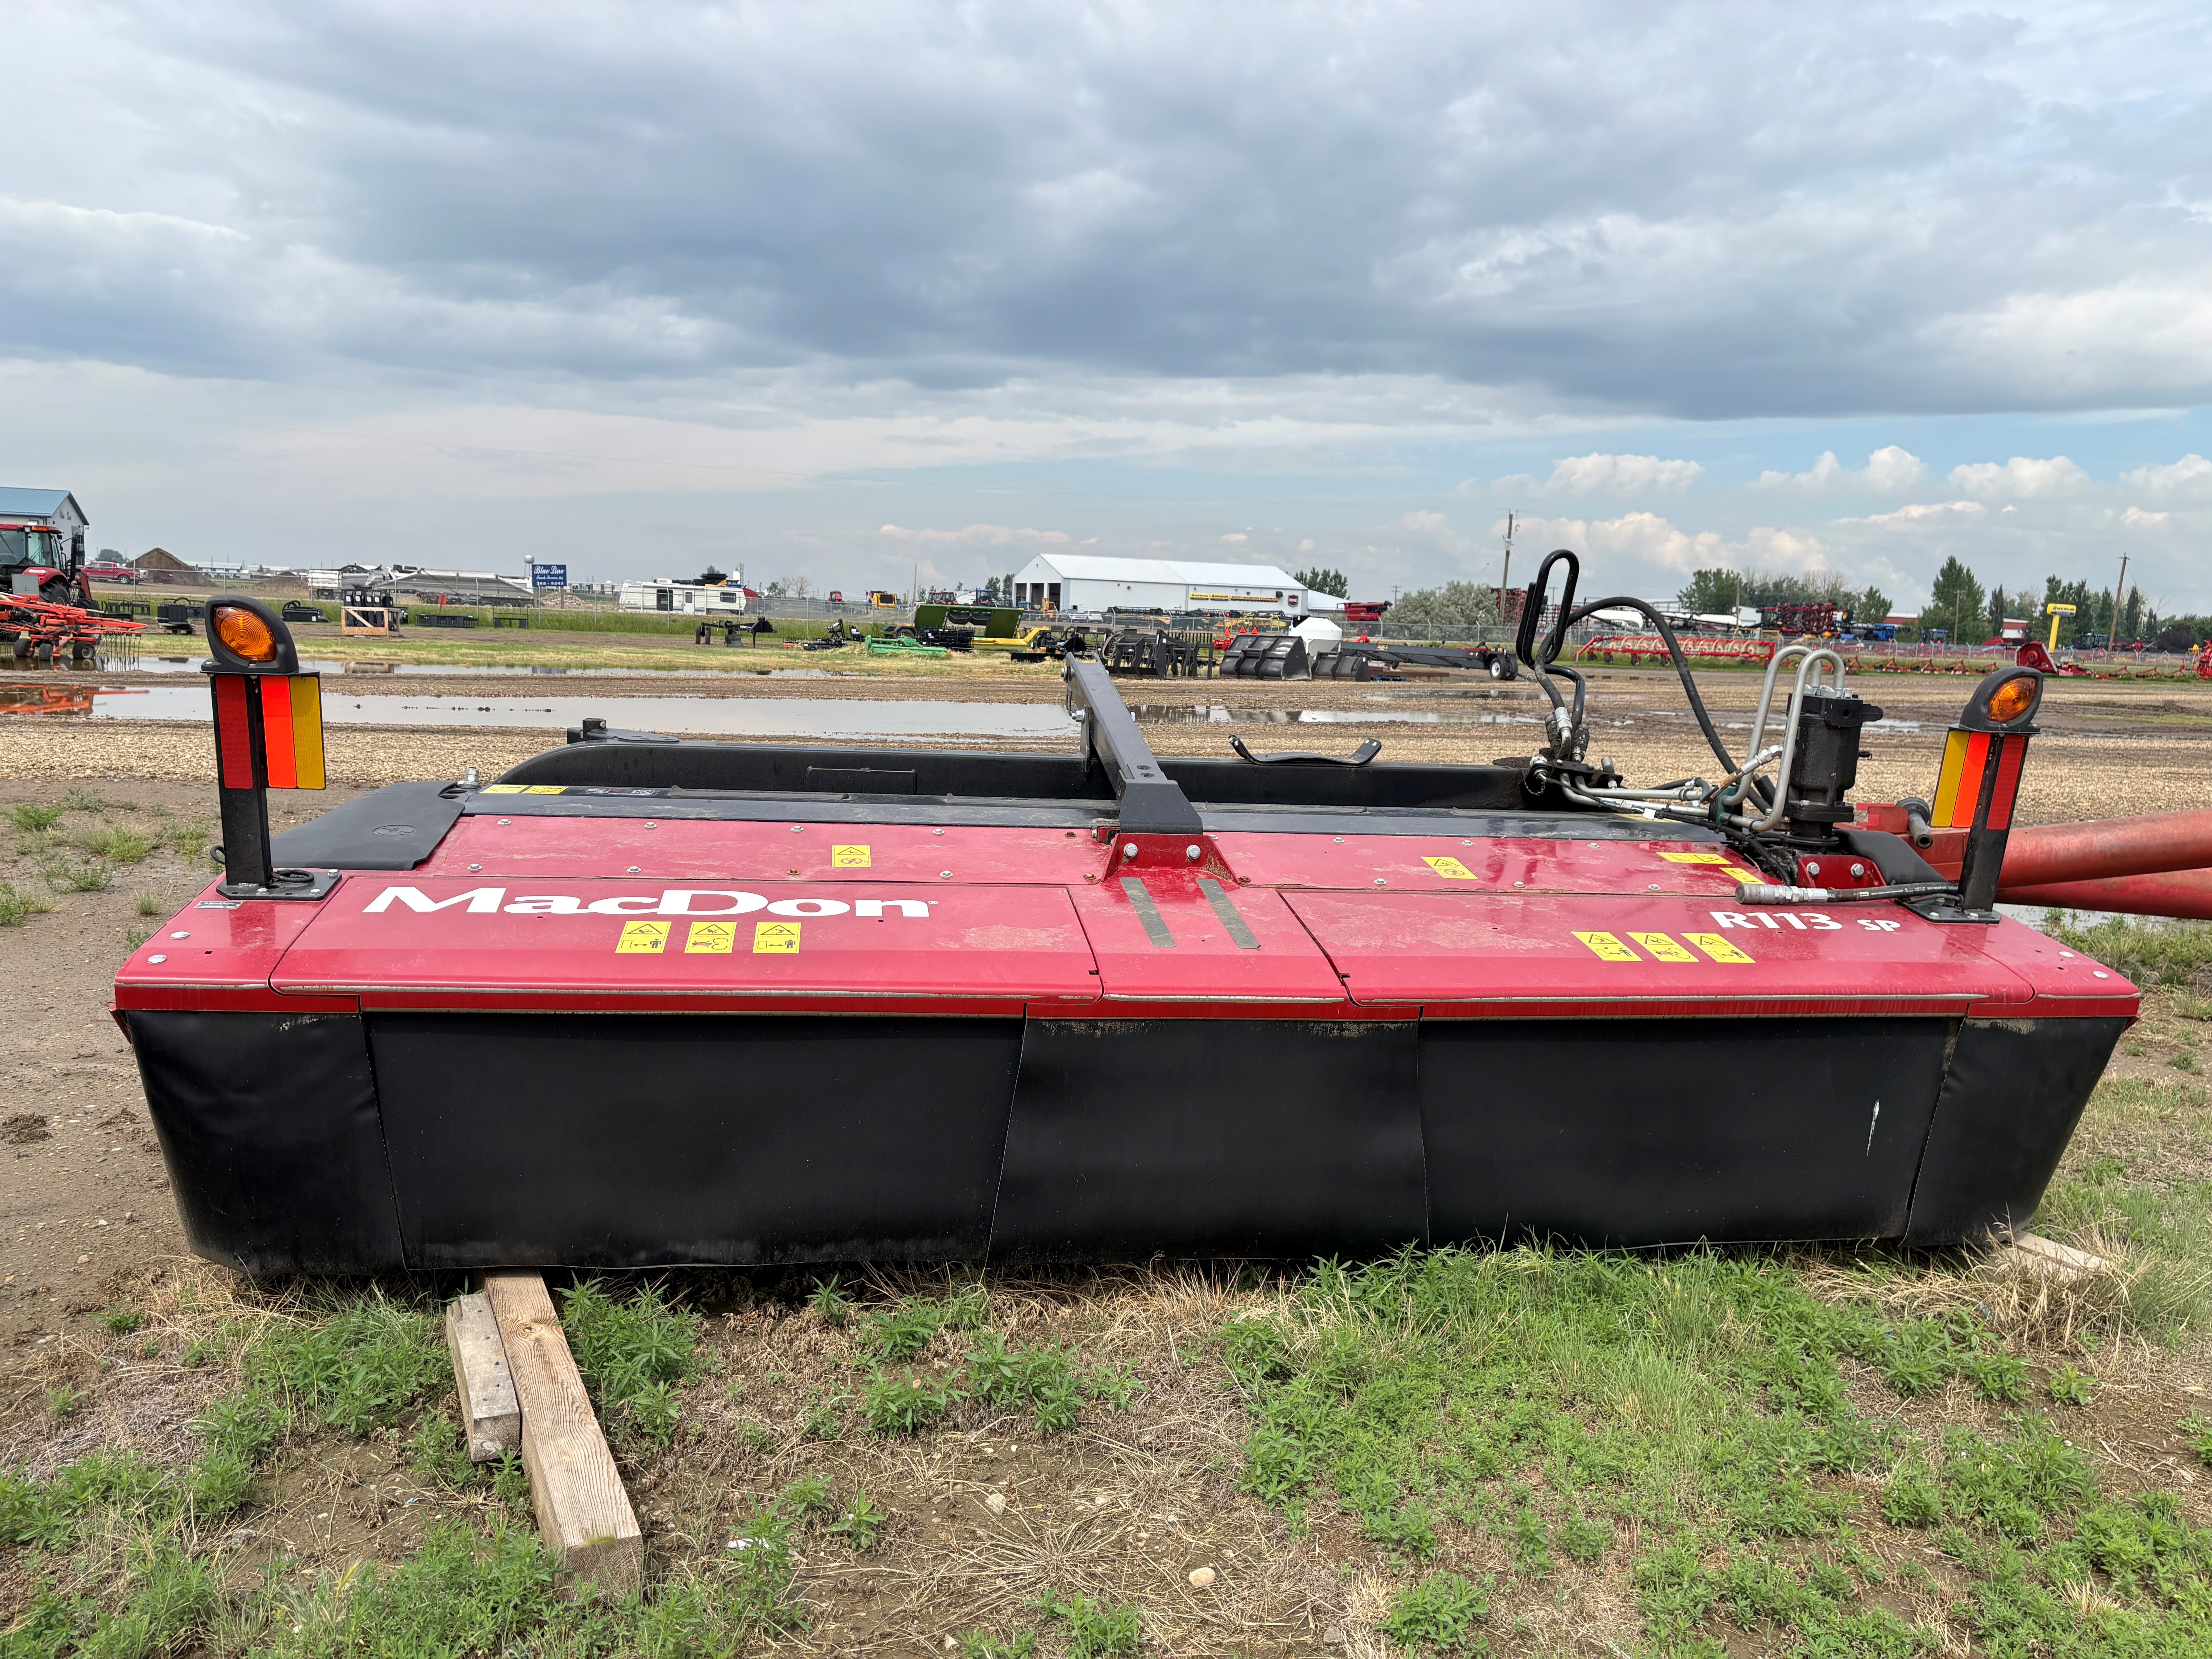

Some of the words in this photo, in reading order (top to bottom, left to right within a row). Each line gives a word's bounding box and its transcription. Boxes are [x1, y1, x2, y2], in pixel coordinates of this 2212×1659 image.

[534, 565, 550, 574] Blue
[550, 565, 565, 574] Line
[362, 886, 928, 917] MacDon
[1709, 911, 1843, 930] R113
[1857, 919, 1901, 931] SP
